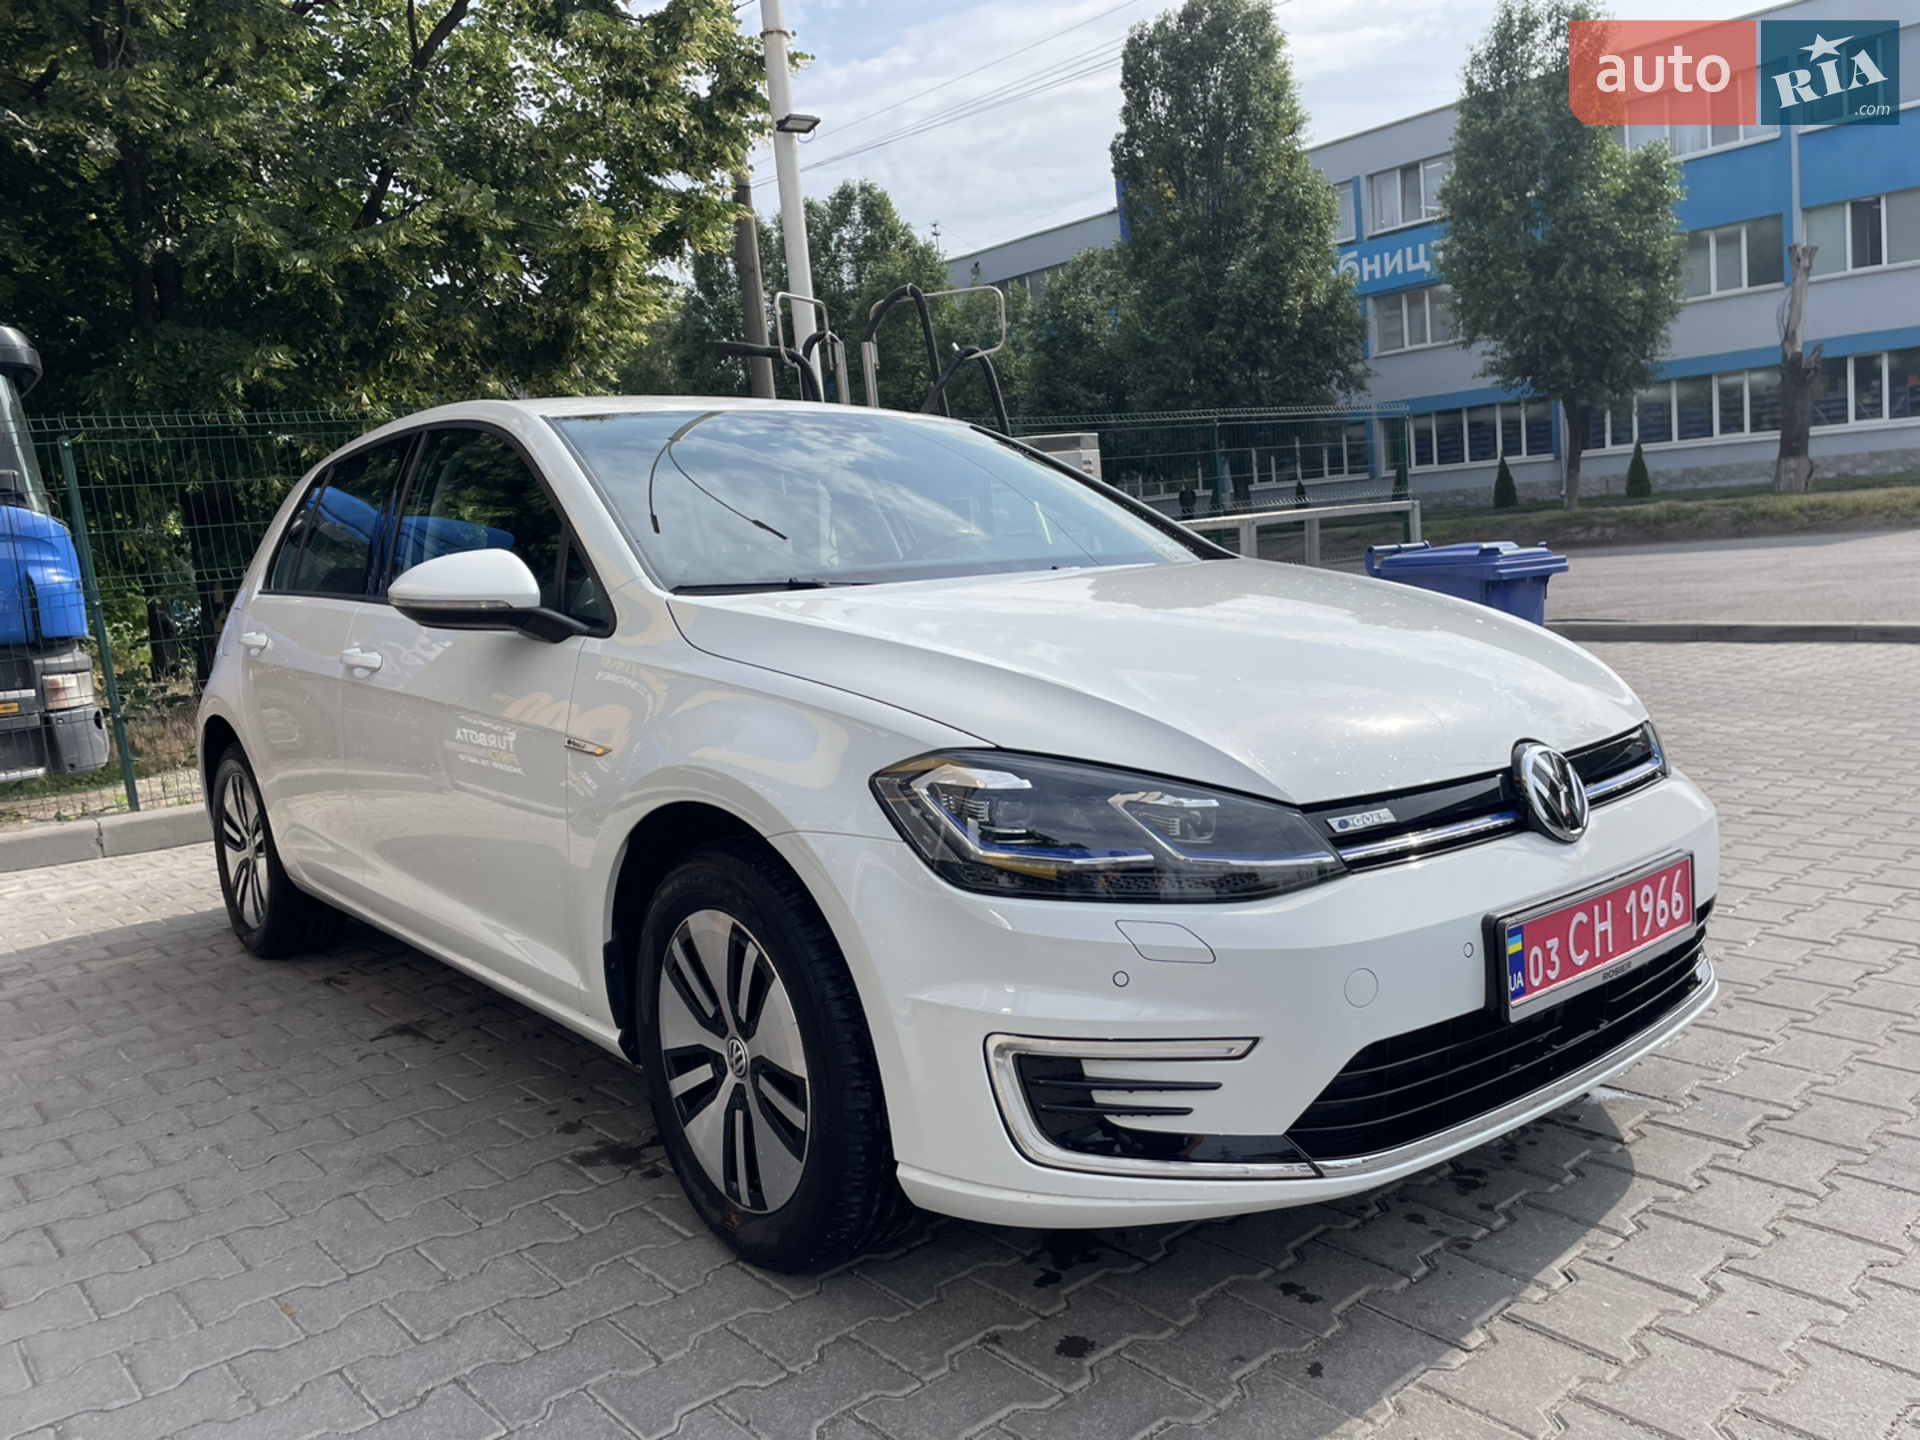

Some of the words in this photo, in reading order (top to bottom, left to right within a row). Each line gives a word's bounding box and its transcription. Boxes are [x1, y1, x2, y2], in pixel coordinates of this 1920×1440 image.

[1529, 937, 1560, 987] 03
[1568, 900, 1613, 966] CH
[1625, 869, 1684, 941] 1966
[1509, 971, 1524, 991] UA
